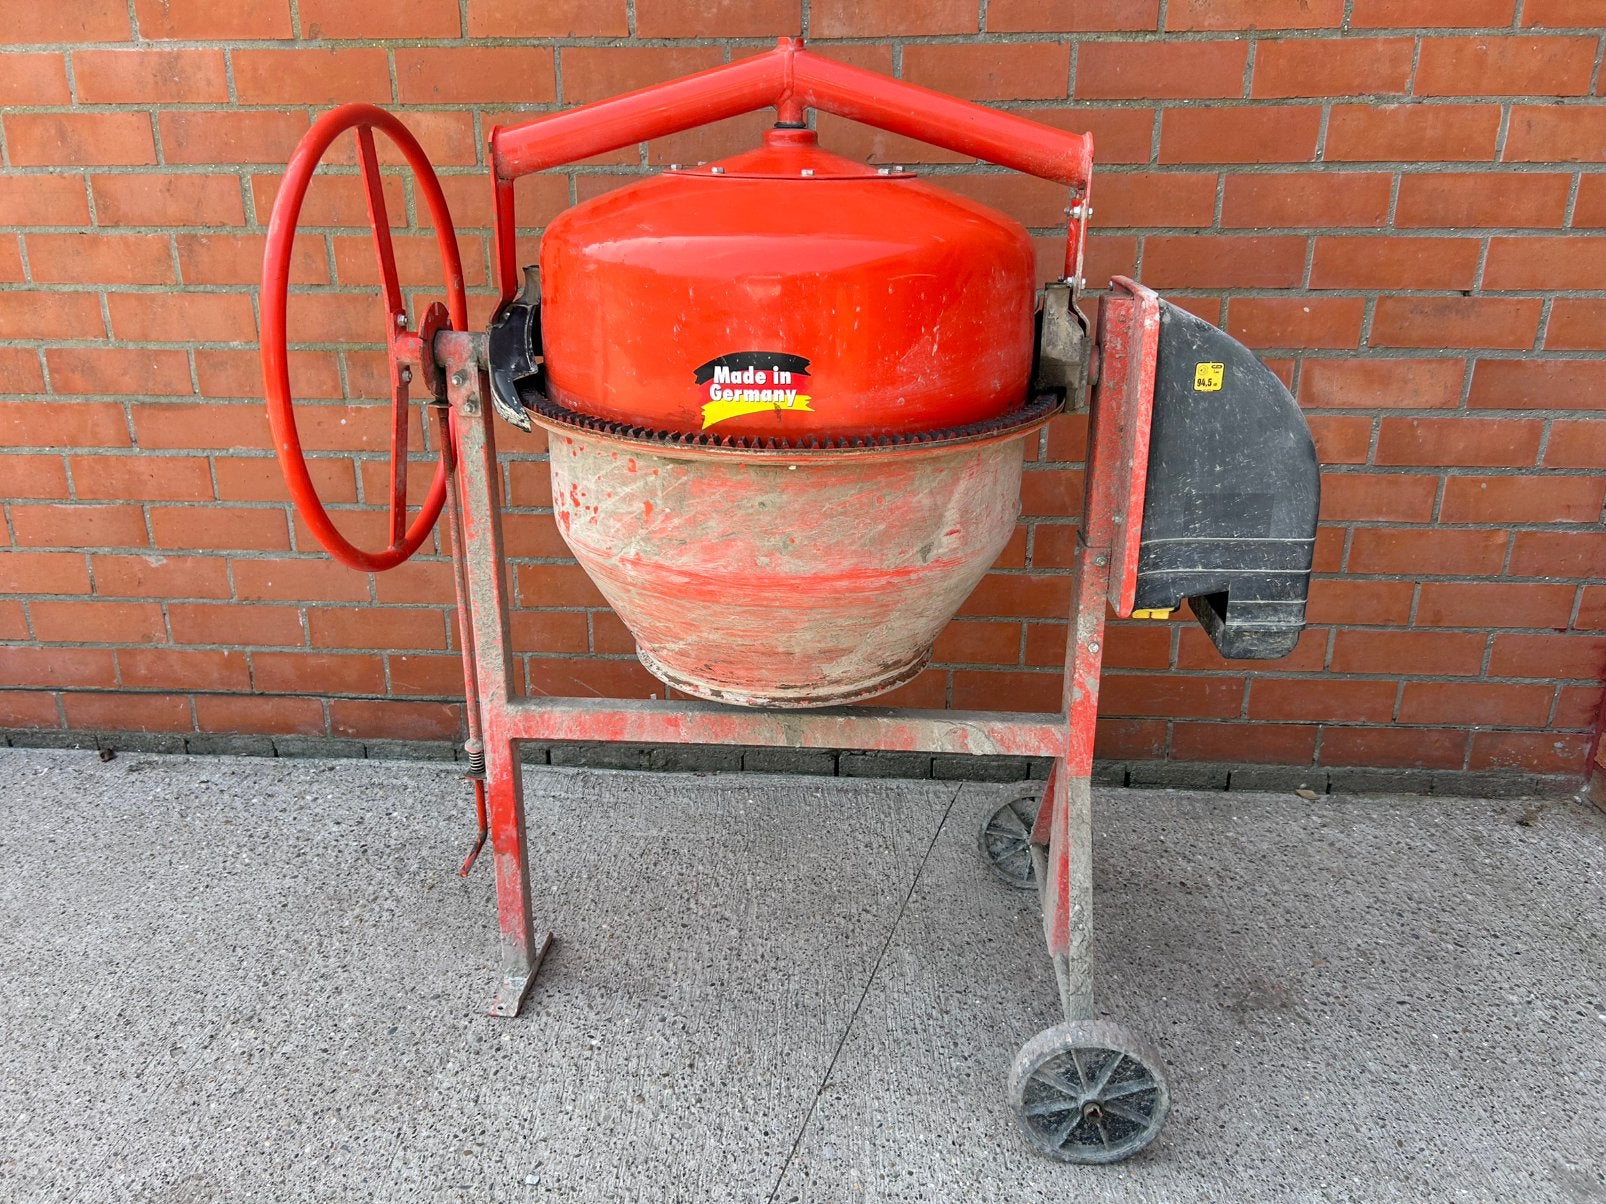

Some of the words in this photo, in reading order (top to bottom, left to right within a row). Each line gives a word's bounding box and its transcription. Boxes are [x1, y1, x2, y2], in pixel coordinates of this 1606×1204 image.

[713, 366, 766, 384] Made
[773, 366, 791, 385] in
[709, 384, 797, 407] Germany
